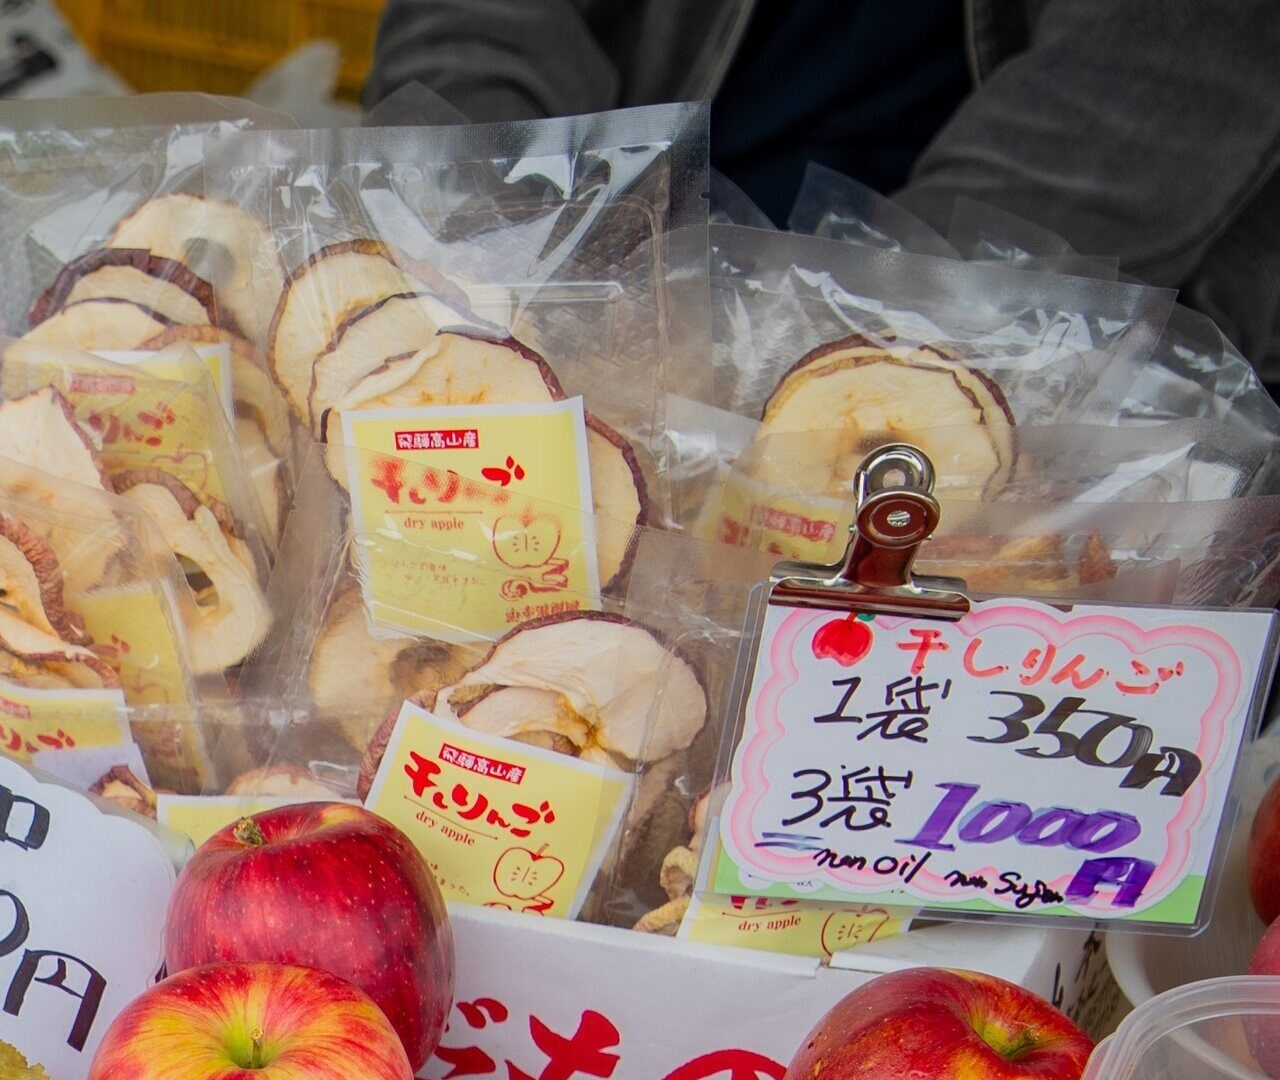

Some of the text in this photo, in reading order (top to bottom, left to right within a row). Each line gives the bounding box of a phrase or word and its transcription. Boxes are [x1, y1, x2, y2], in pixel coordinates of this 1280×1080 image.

[403, 517, 464, 535] dry apple
[966, 690, 1204, 798] 350円
[415, 810, 476, 847] dry apple
[895, 782, 1142, 853] 1000
[737, 914, 802, 933] dry apple
